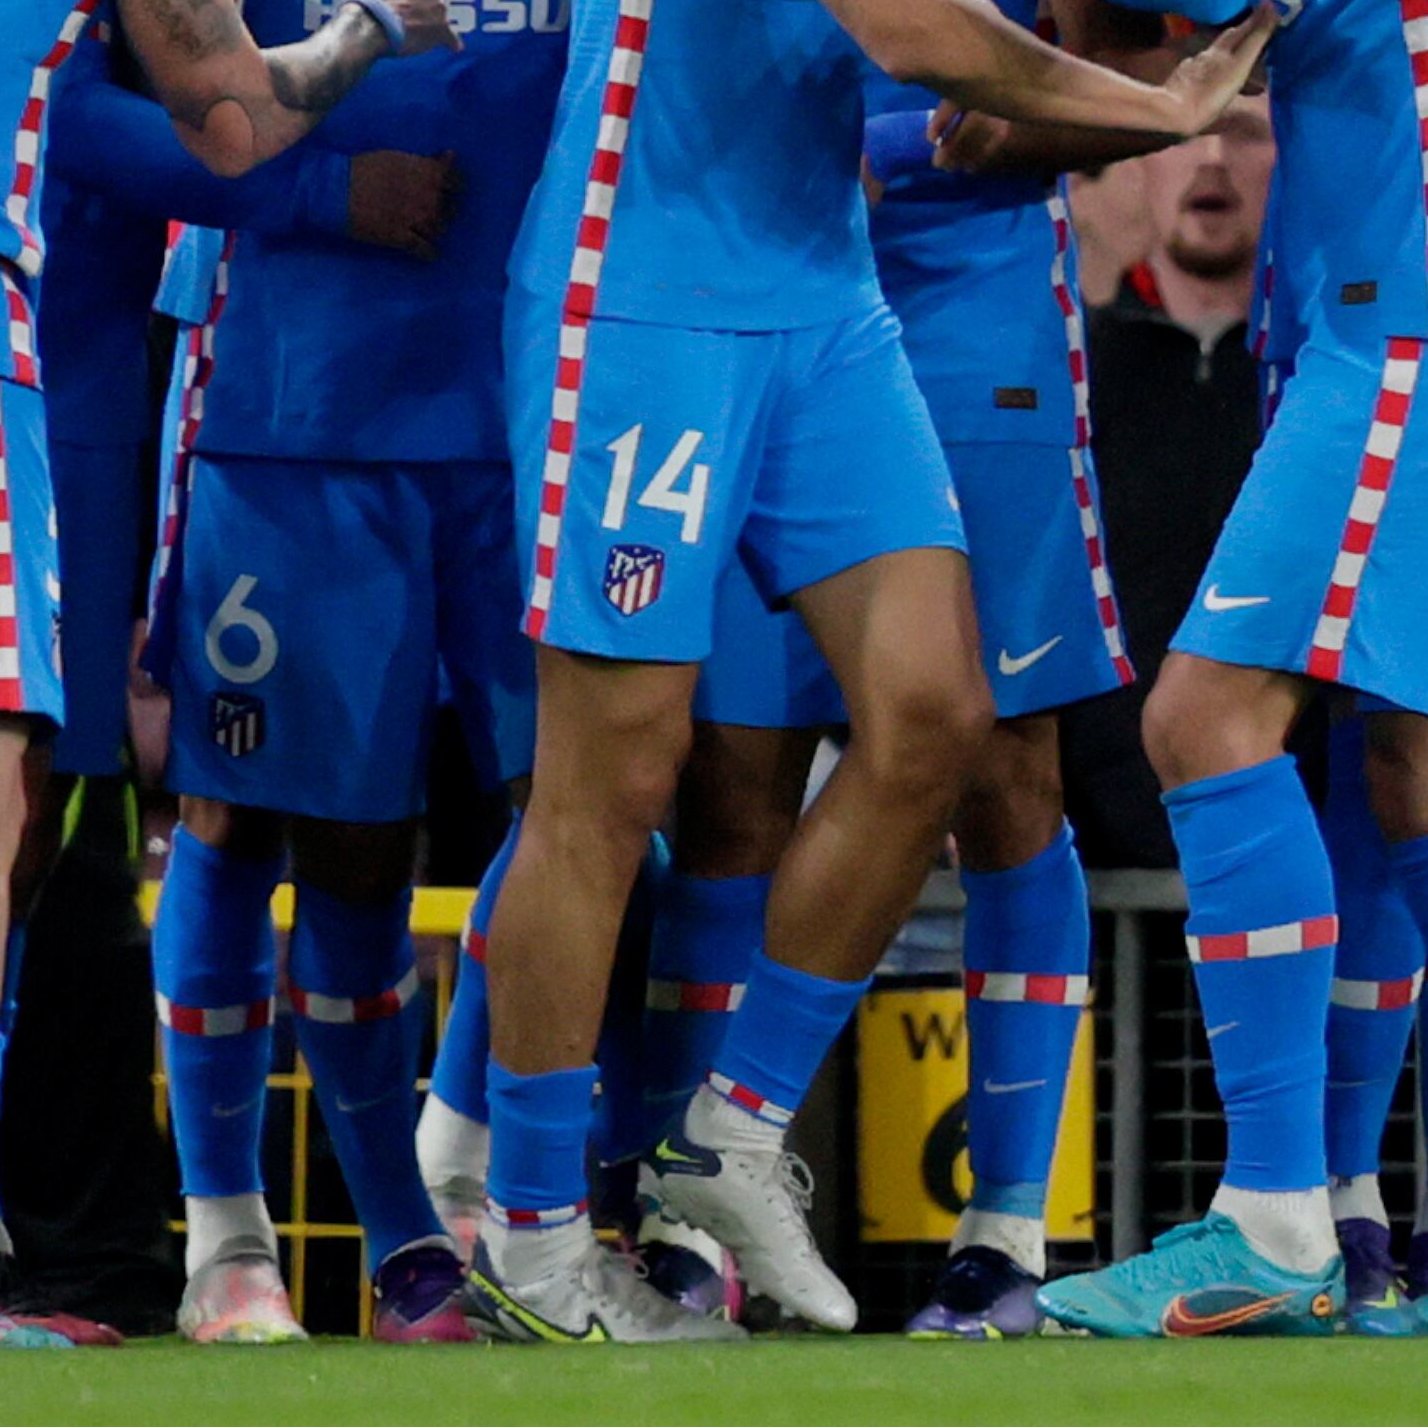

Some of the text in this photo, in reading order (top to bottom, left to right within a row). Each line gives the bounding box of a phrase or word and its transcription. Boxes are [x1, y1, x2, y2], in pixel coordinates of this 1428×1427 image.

[602, 423, 711, 544] 14
[205, 574, 278, 685] 6
[901, 1010, 967, 1063] W
